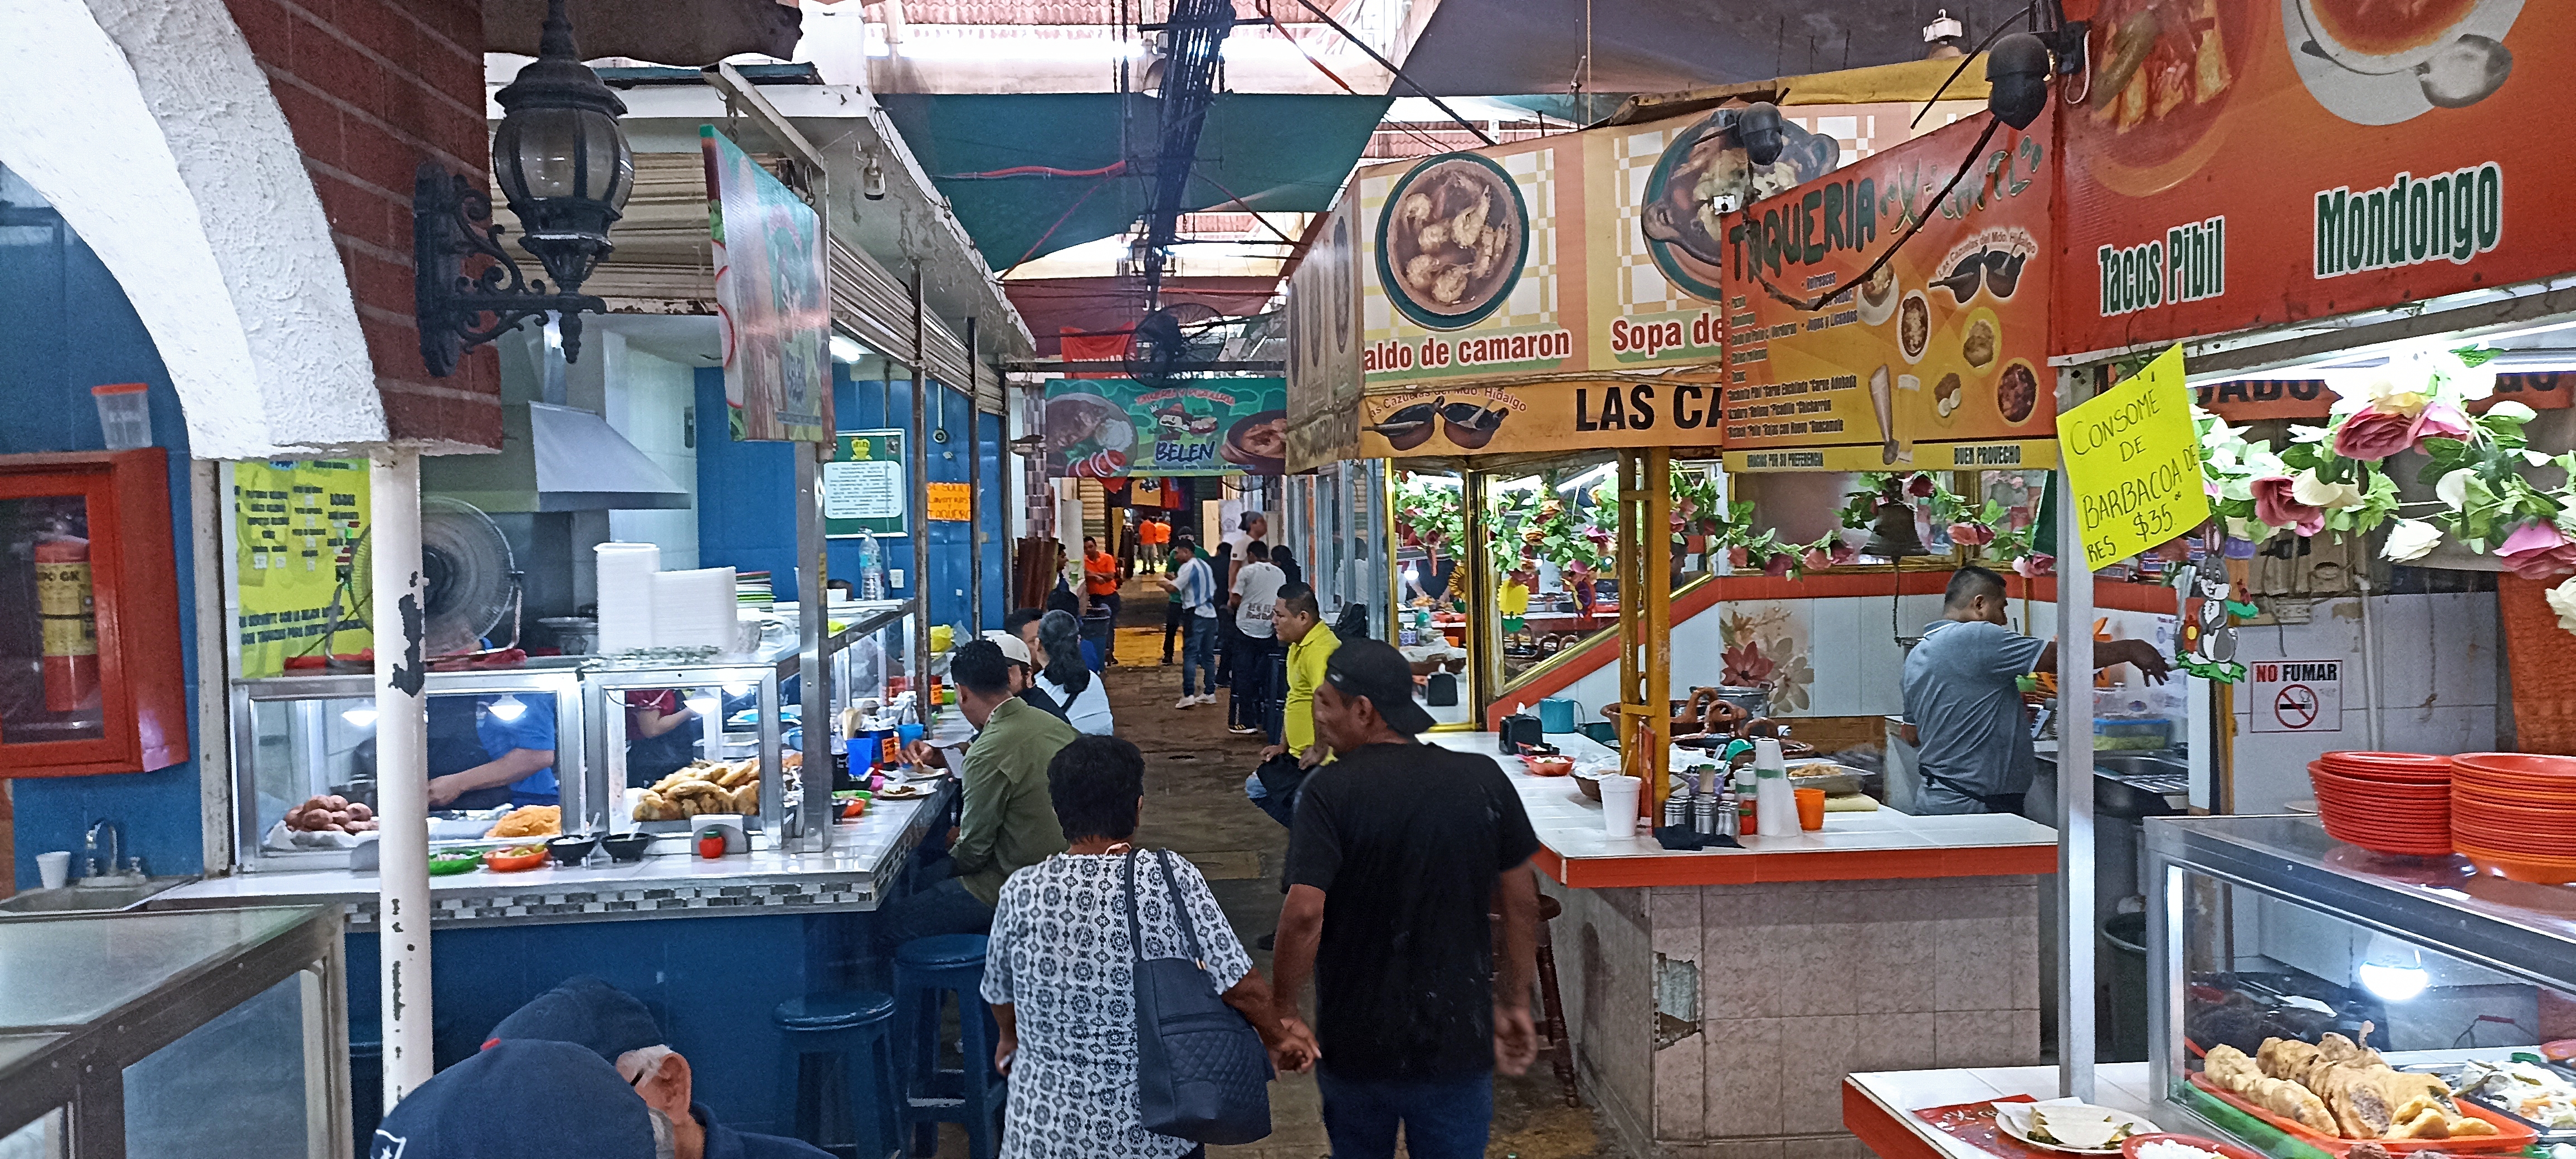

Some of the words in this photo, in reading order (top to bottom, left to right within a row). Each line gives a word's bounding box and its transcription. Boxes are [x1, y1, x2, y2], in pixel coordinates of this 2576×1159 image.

[1729, 177, 1876, 284] TAQUERIA
[2316, 164, 2500, 276] Mondongo
[2099, 241, 2162, 315] Tacos
[2168, 217, 2224, 304] Pibil
[1364, 342, 1412, 371] aldo
[1421, 338, 1449, 366] de
[1458, 332, 1570, 363] camaron
[1612, 320, 1682, 356] Sopa
[1694, 313, 1723, 344] de
[1485, 388, 1528, 412] Hidalgo
[1576, 384, 1655, 431] LAS
[1155, 440, 1216, 462] BELEN
[1954, 447, 1974, 464] BUEN
[1977, 445, 2021, 464] PROVECHO
[2119, 435, 2146, 462] DE
[2082, 458, 2182, 532] BARBACOA
[2182, 444, 2198, 472] DE
[2087, 535, 2116, 563] RES
[2256, 664, 2278, 682] NO
[2282, 664, 2338, 682] FUMAR
